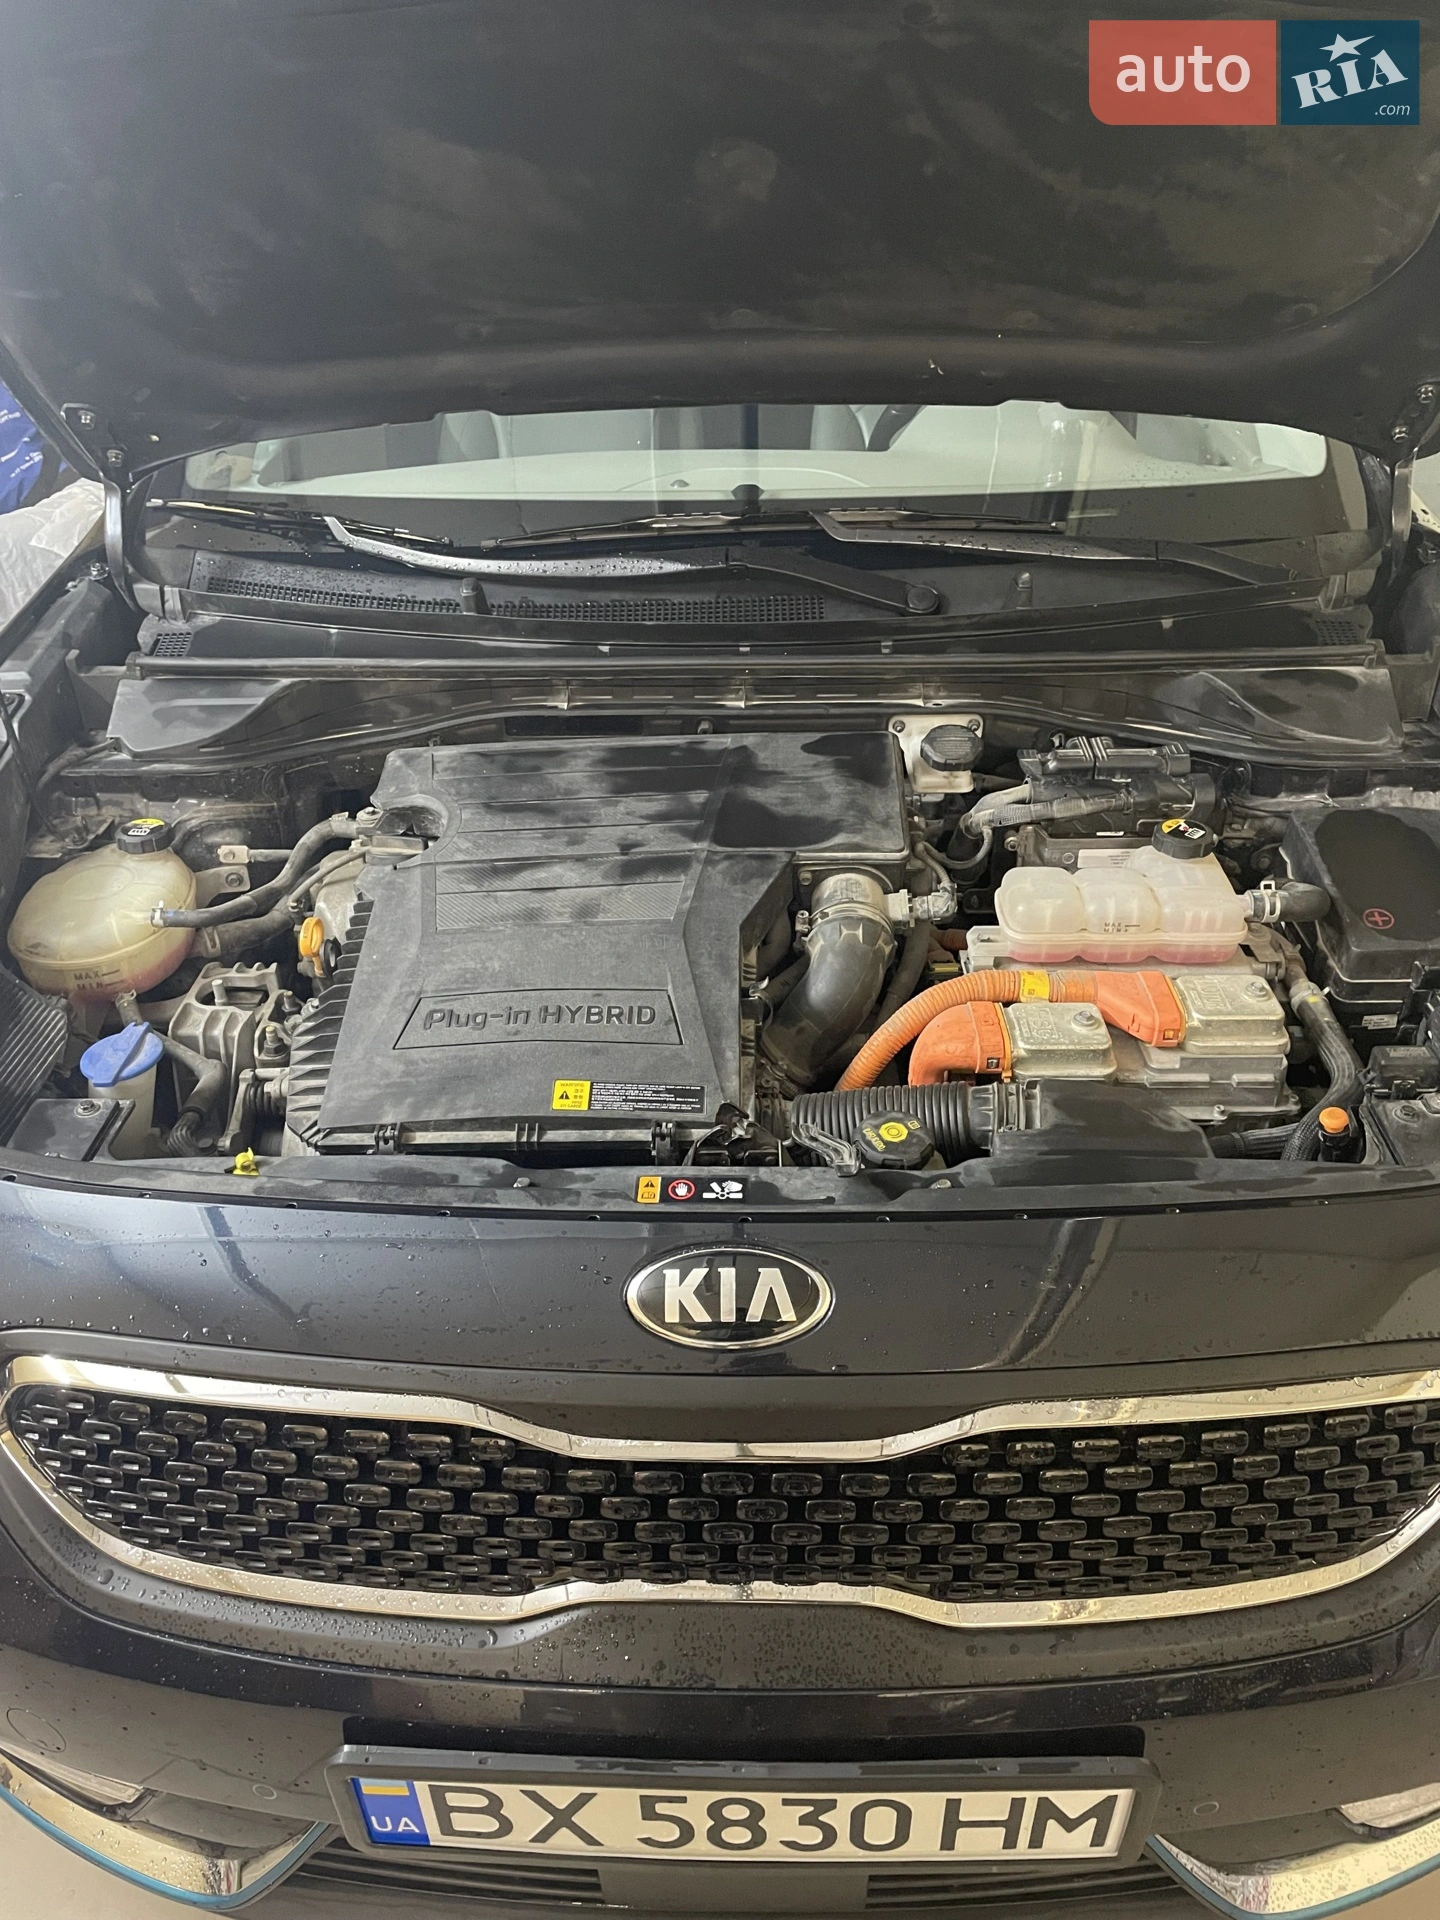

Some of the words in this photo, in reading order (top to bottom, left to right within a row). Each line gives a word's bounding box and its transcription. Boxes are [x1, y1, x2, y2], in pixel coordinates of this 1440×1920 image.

[74, 970, 100, 980] MAX
[77, 982, 103, 991] MIN
[423, 1006, 531, 1031] Plug-in
[539, 1004, 656, 1025] HYBRID
[663, 1267, 797, 1323] KIA
[370, 1816, 420, 1834] UA
[428, 1784, 604, 1847] BX
[637, 1795, 913, 1852] 5830
[939, 1794, 1118, 1852] HM
